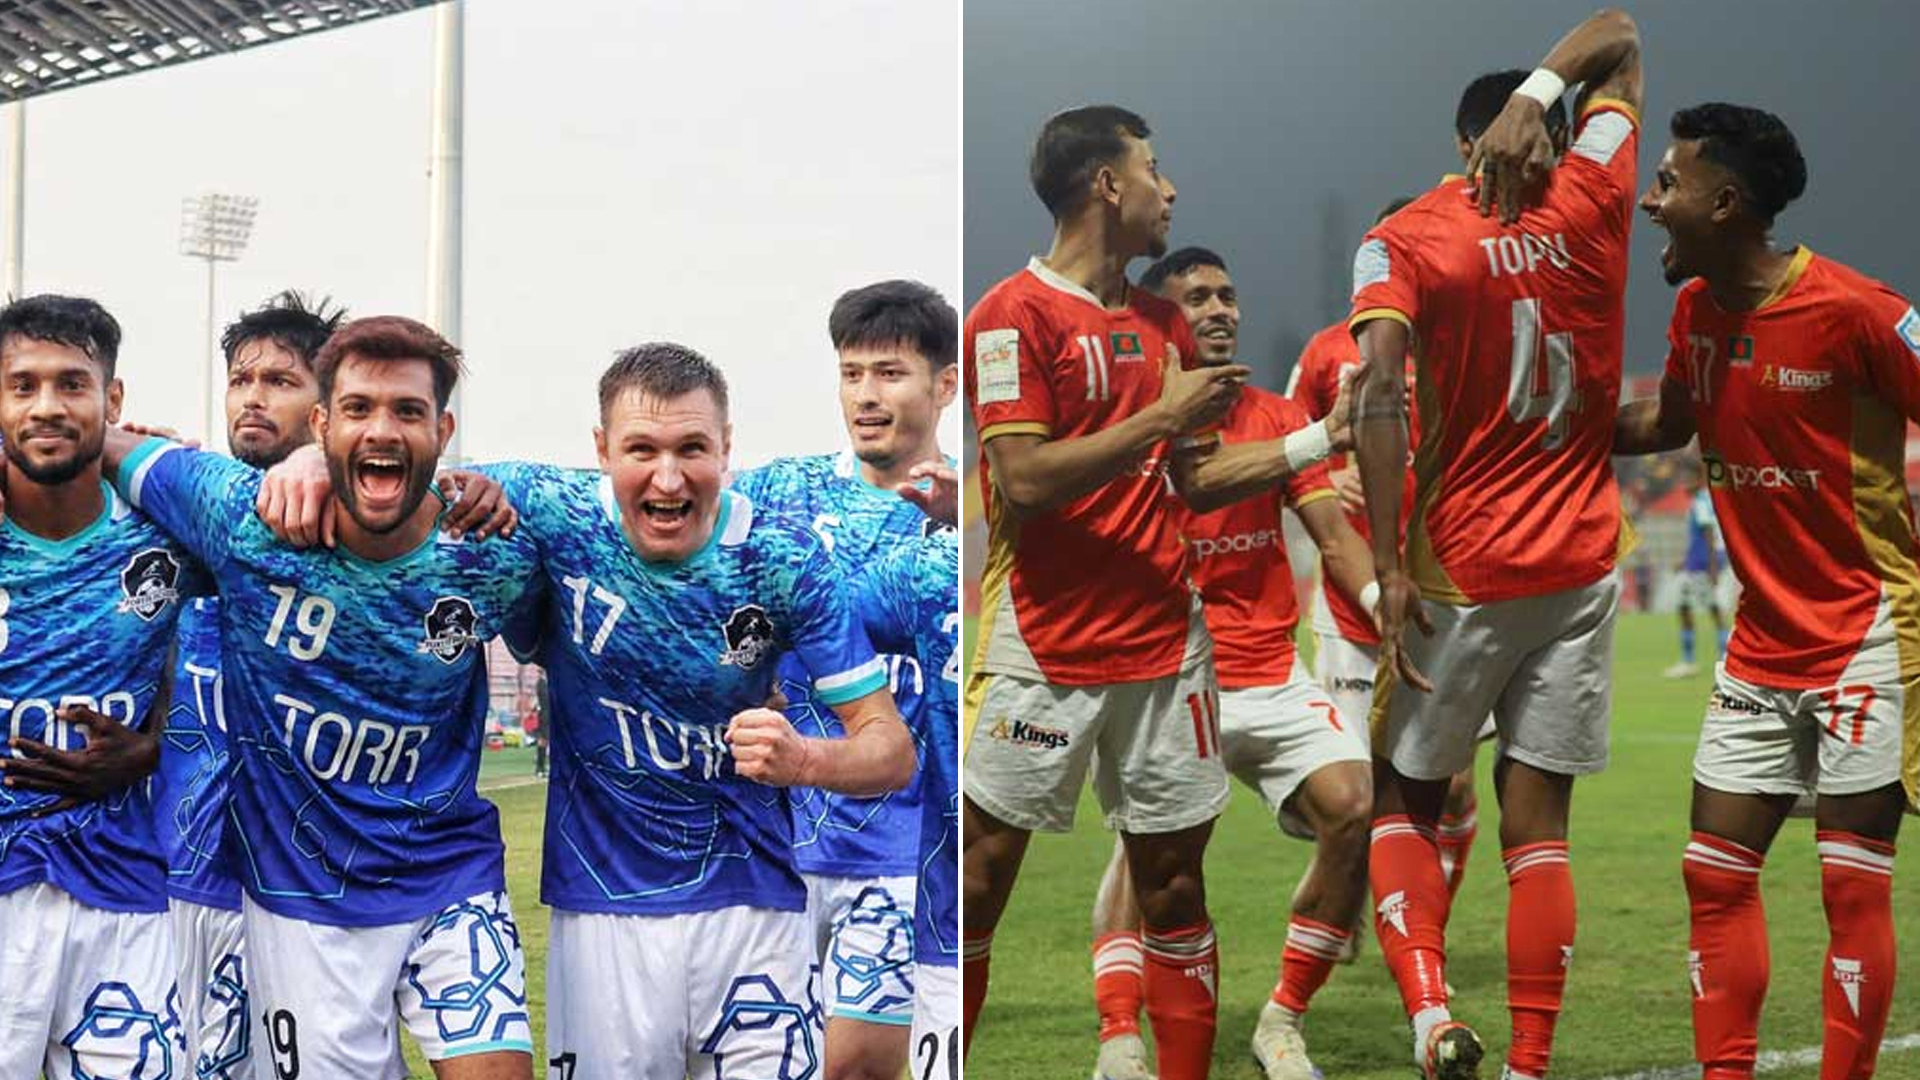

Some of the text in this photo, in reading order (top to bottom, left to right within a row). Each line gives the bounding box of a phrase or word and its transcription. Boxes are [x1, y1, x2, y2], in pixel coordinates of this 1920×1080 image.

[1480, 232, 1573, 279] TOPU
[1076, 335, 1108, 401] 11
[1508, 298, 1584, 450] 4
[264, 584, 337, 662] 19
[563, 576, 626, 655] 17
[0, 691, 136, 760] ORR
[274, 693, 430, 784] TORR
[1012, 719, 1069, 749] Kings
[1187, 689, 1218, 759] 11
[262, 1009, 299, 1080] 19
